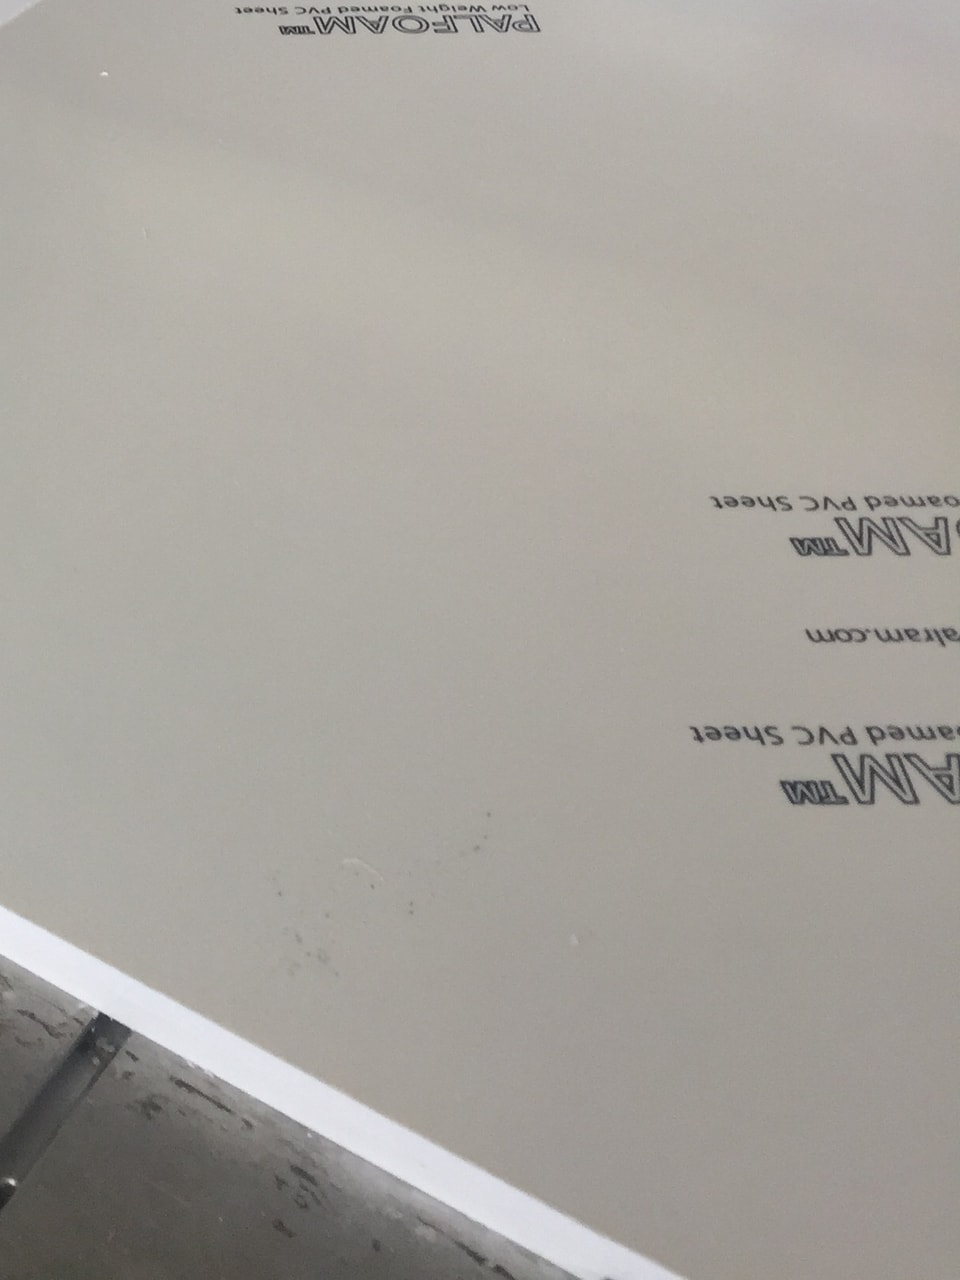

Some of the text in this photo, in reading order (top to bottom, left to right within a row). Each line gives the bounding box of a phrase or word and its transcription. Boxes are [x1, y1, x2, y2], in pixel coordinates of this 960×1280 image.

[235, 4, 529, 15] Low Weight Foamed PVC Sheet
[710, 495, 793, 512] Sheet
[799, 496, 857, 512] PVC
[689, 725, 960, 746] amed PVC Sheet
